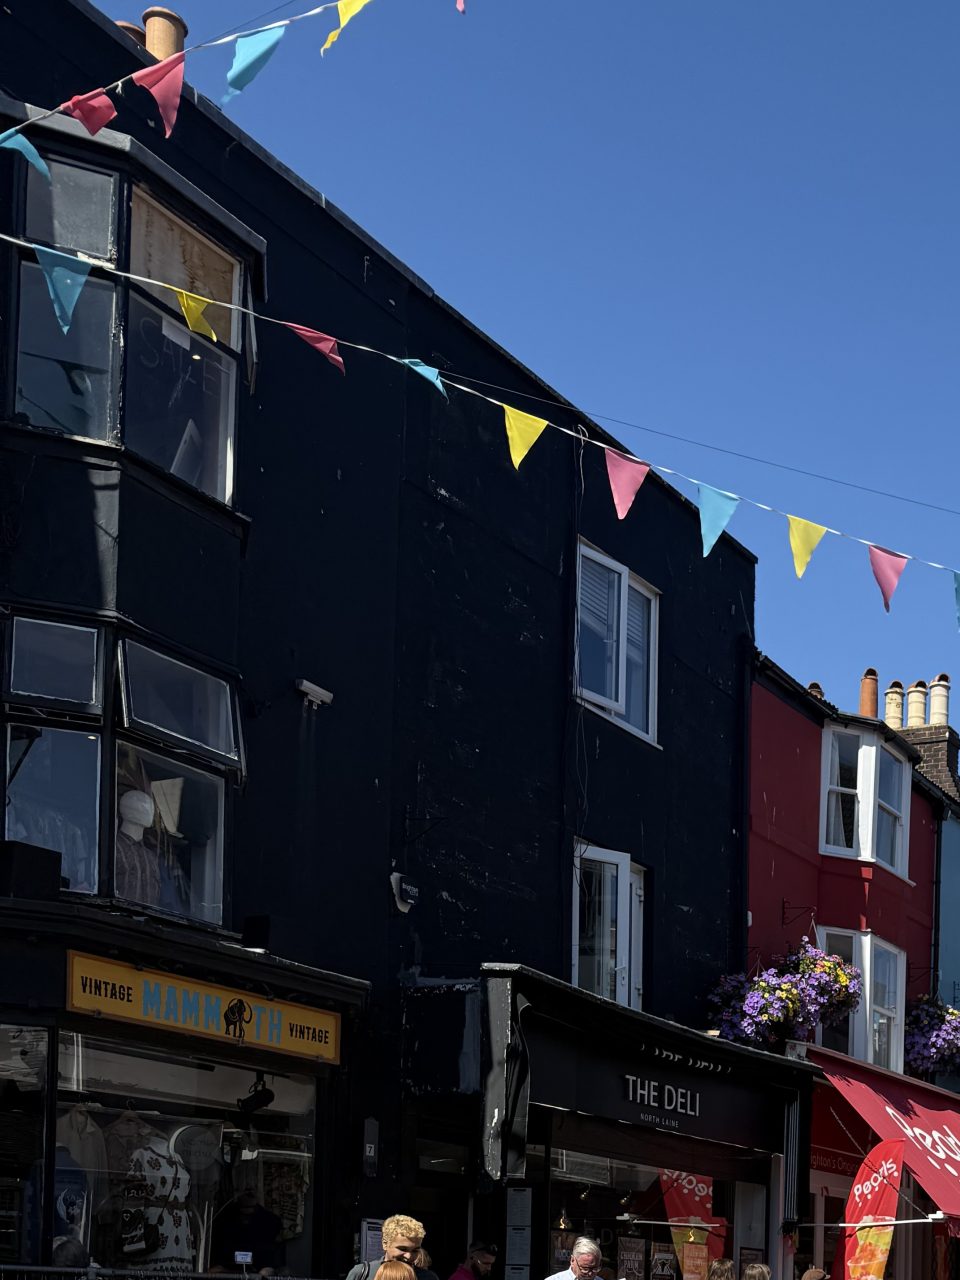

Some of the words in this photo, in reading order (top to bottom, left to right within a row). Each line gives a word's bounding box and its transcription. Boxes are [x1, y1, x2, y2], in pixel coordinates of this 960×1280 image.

[80, 975, 133, 1003] VINTAGE
[142, 980, 283, 1045] MAMMTH
[288, 1022, 329, 1045] VINTAGE
[625, 1074, 659, 1108] THE
[664, 1085, 700, 1117] DELI
[640, 1113, 660, 1125] NORTH
[662, 1117, 679, 1128] LAINE
[367, 1145, 374, 1155] 7
[853, 1158, 898, 1203] Pearls
